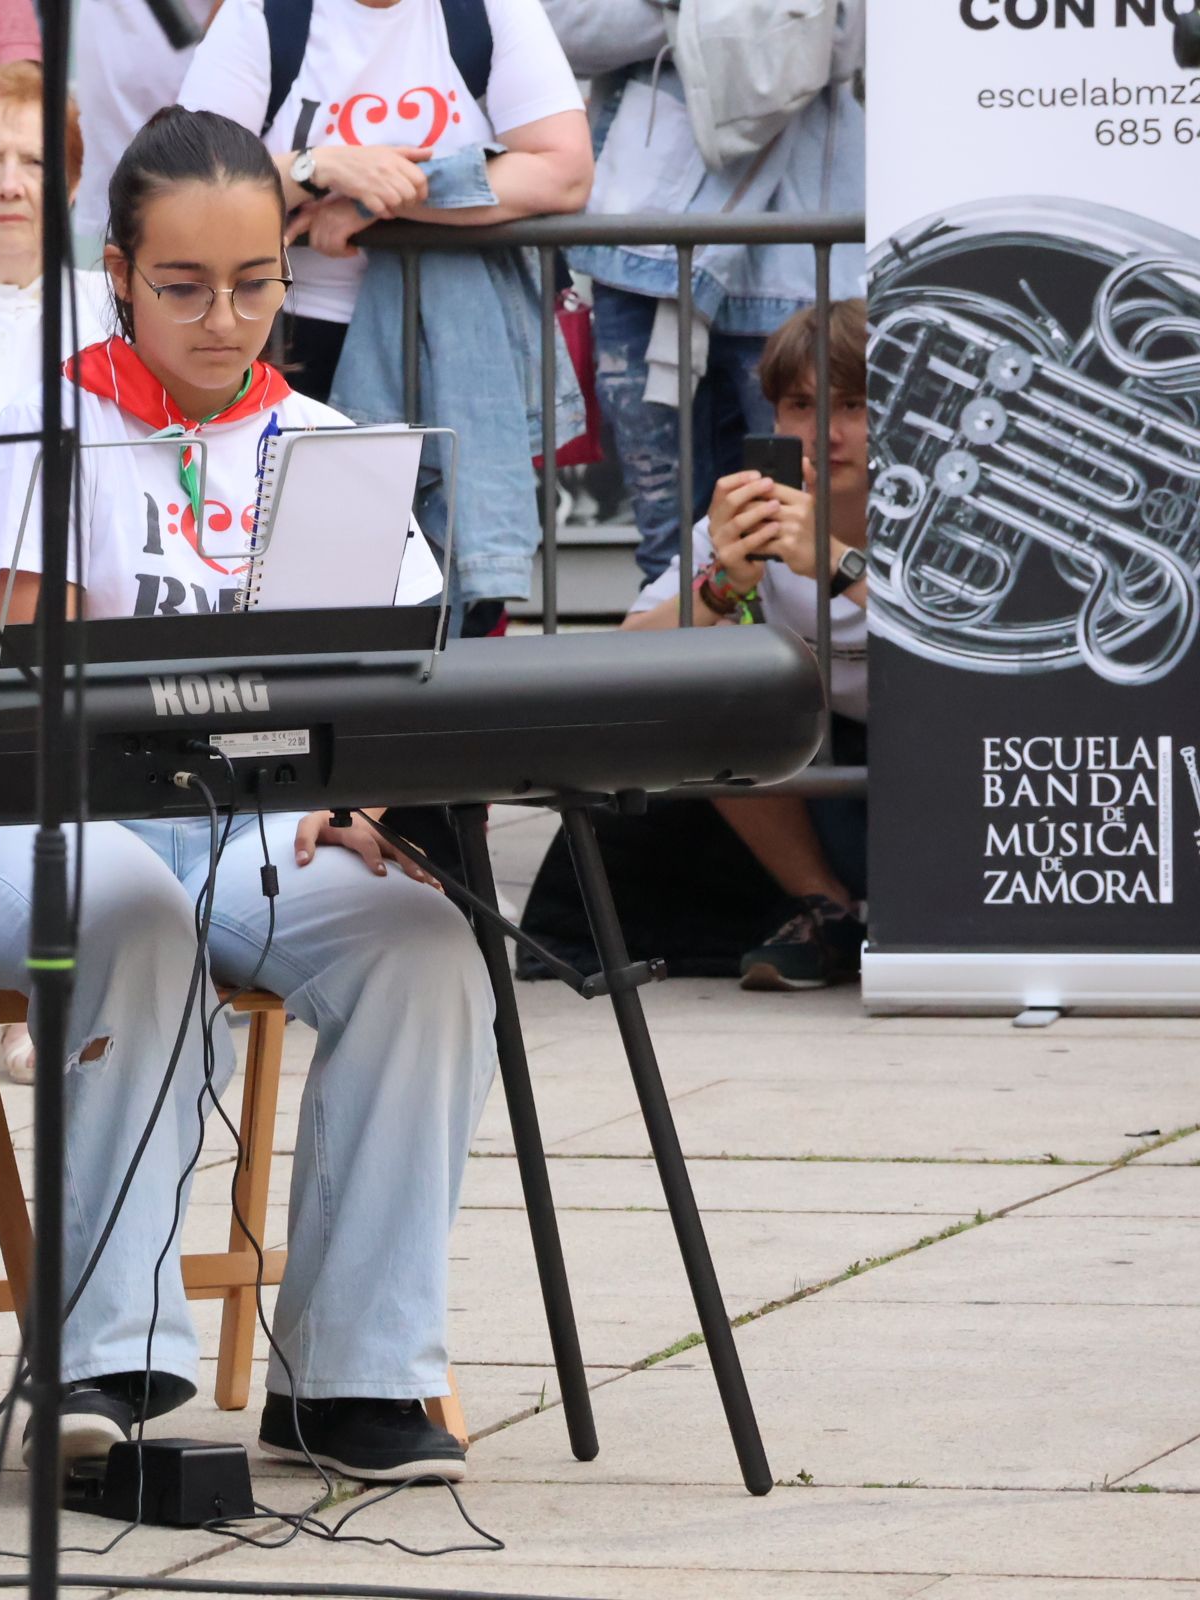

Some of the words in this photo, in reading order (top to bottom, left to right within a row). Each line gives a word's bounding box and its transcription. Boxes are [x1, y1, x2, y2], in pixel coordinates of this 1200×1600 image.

[959, 0, 1095, 30] CON
[1096, 118, 1162, 146] 685
[1174, 117, 1200, 144] 6
[150, 672, 270, 716] KORG
[983, 736, 1156, 772] ESCUELA
[983, 773, 1157, 807] BANDA
[1102, 806, 1125, 823] DE
[984, 816, 1158, 857] MÚSICA
[1040, 856, 1063, 873] DE
[983, 870, 1158, 904] ZAMORA
